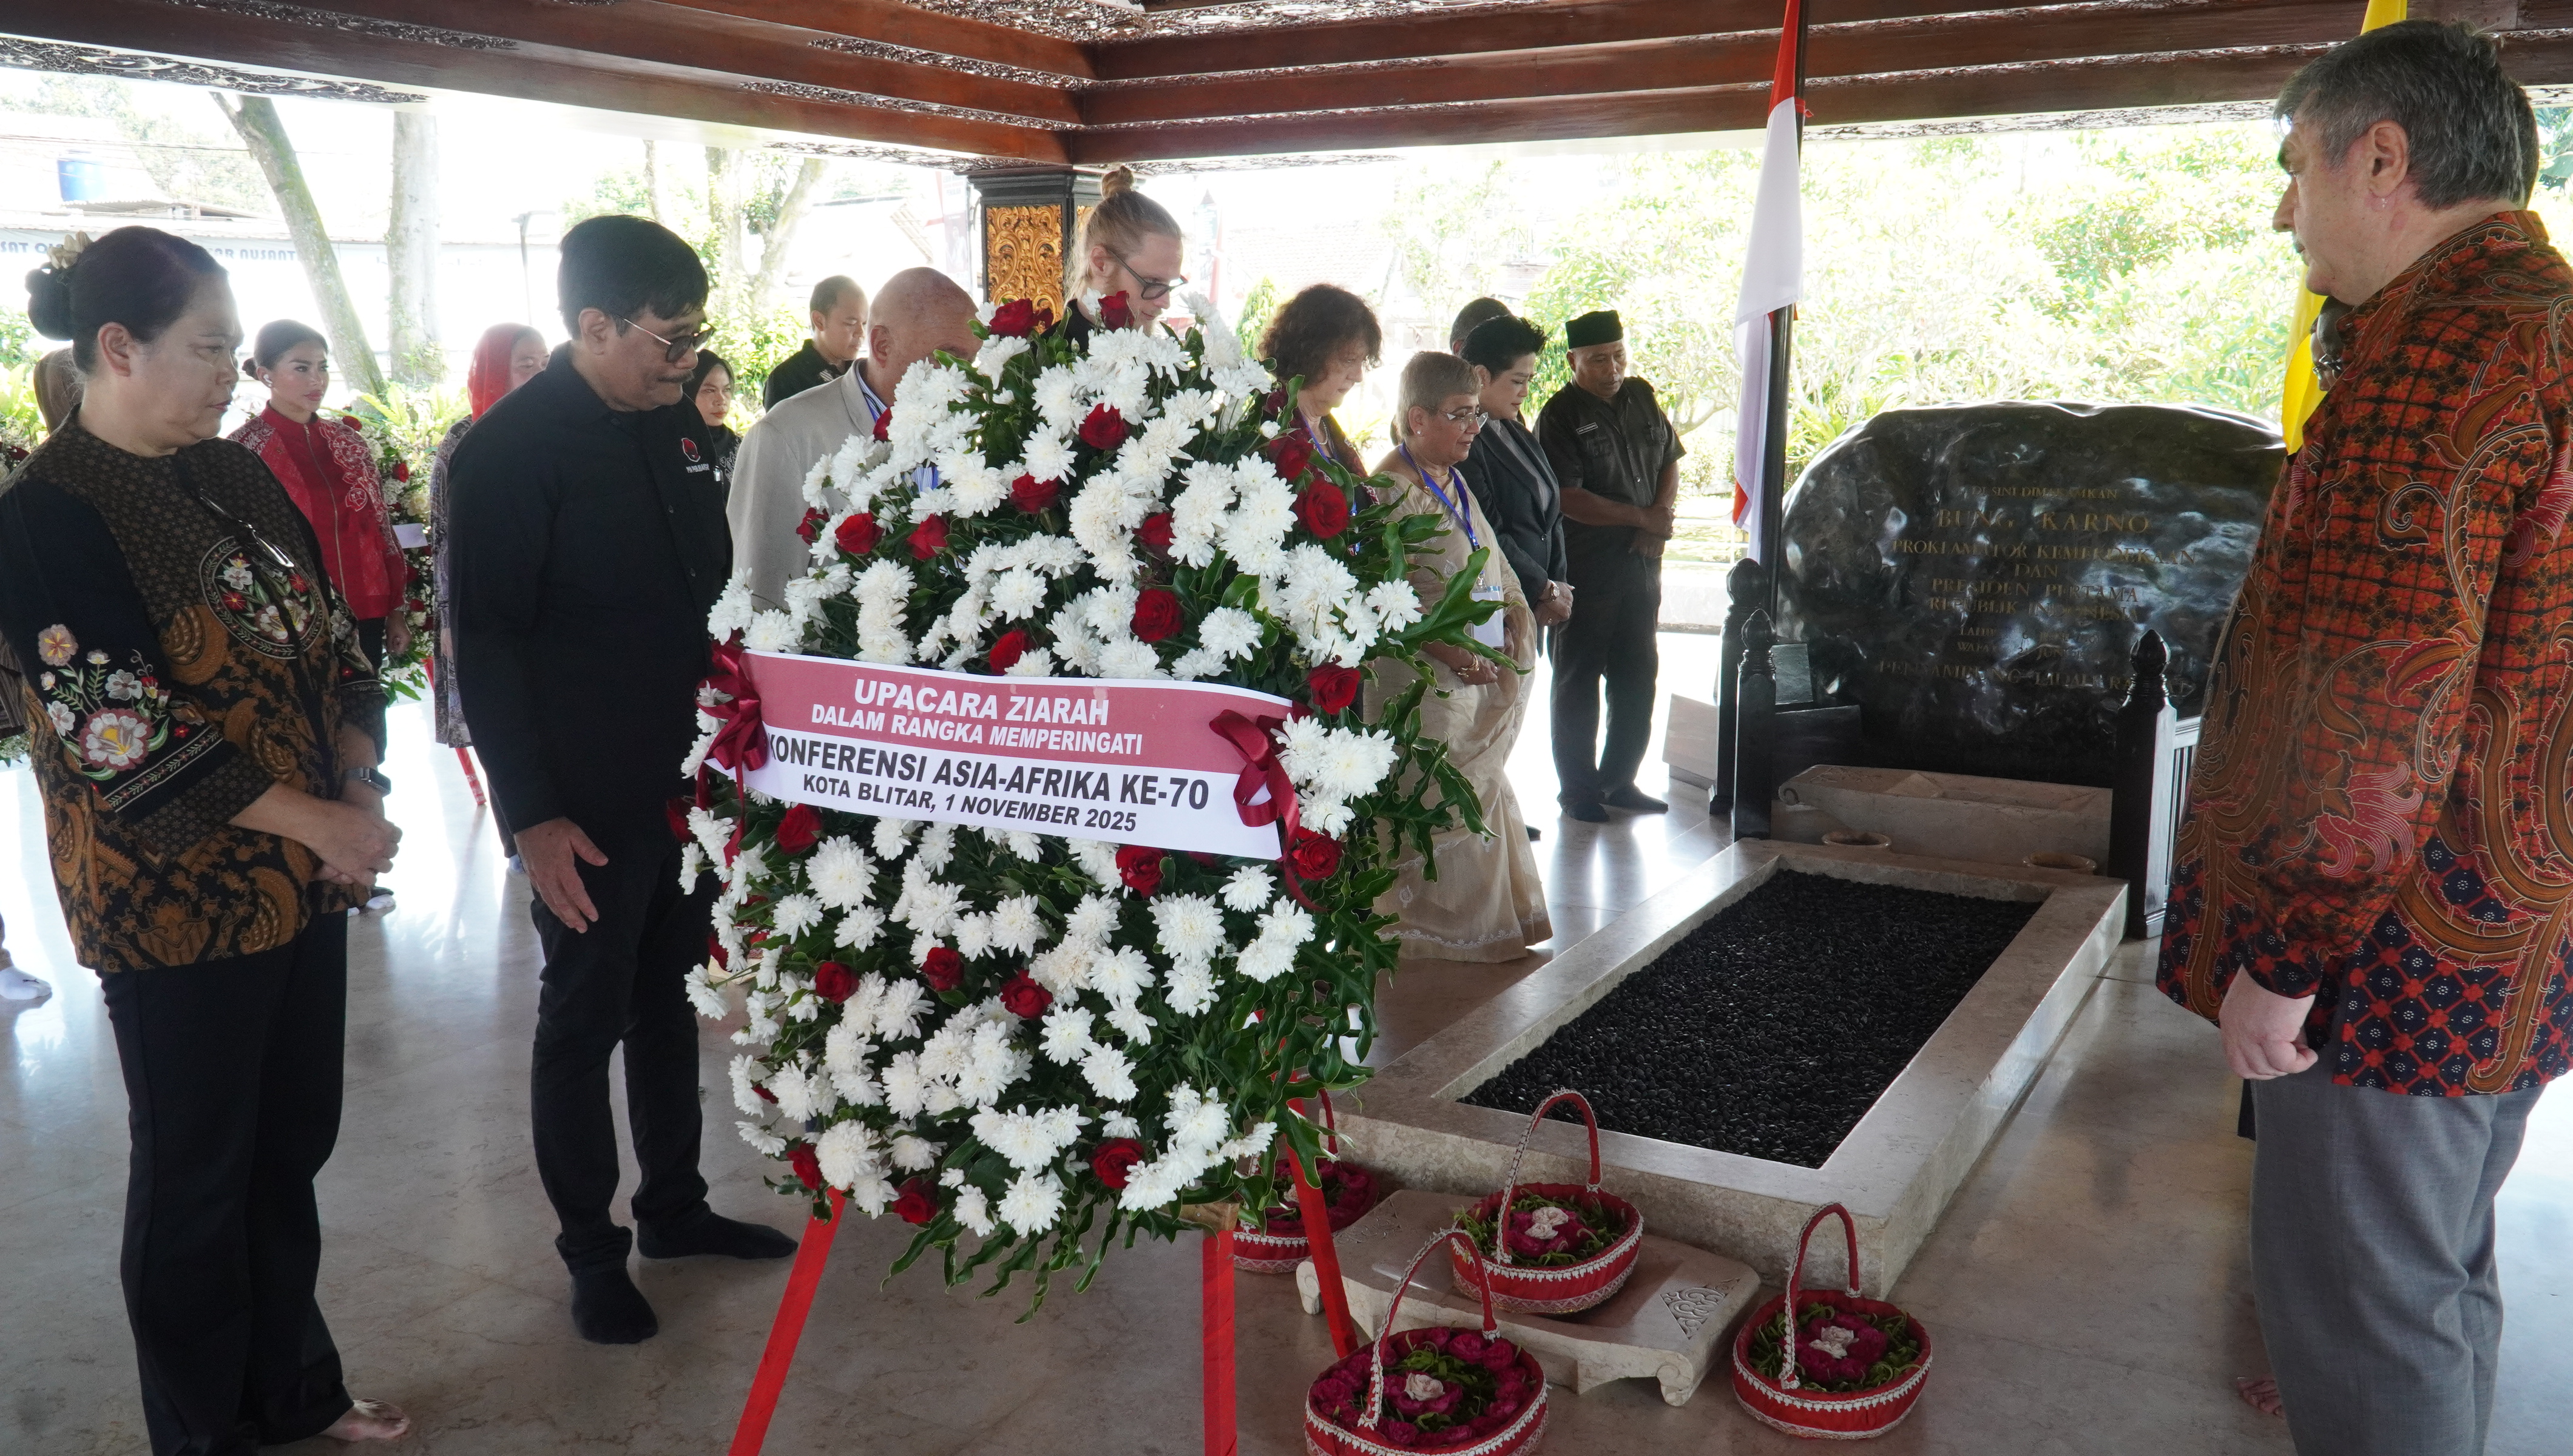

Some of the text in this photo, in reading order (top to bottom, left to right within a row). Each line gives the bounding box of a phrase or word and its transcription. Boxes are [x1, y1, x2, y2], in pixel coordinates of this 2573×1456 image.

[1991, 487, 2016, 497] SINI
[2042, 513, 2150, 534] KARNO
[2015, 564, 2058, 577] DAN
[855, 679, 1109, 726] UPACARA ZIARAH
[812, 704, 1142, 755] DALAM RANGKA MEMPERINGATI
[768, 732, 1208, 809] KONFERENSI ASIA-AFRIKA KE-70
[804, 774, 1136, 831] KOTA BLITAR, 1 NOVEMBER 2025
